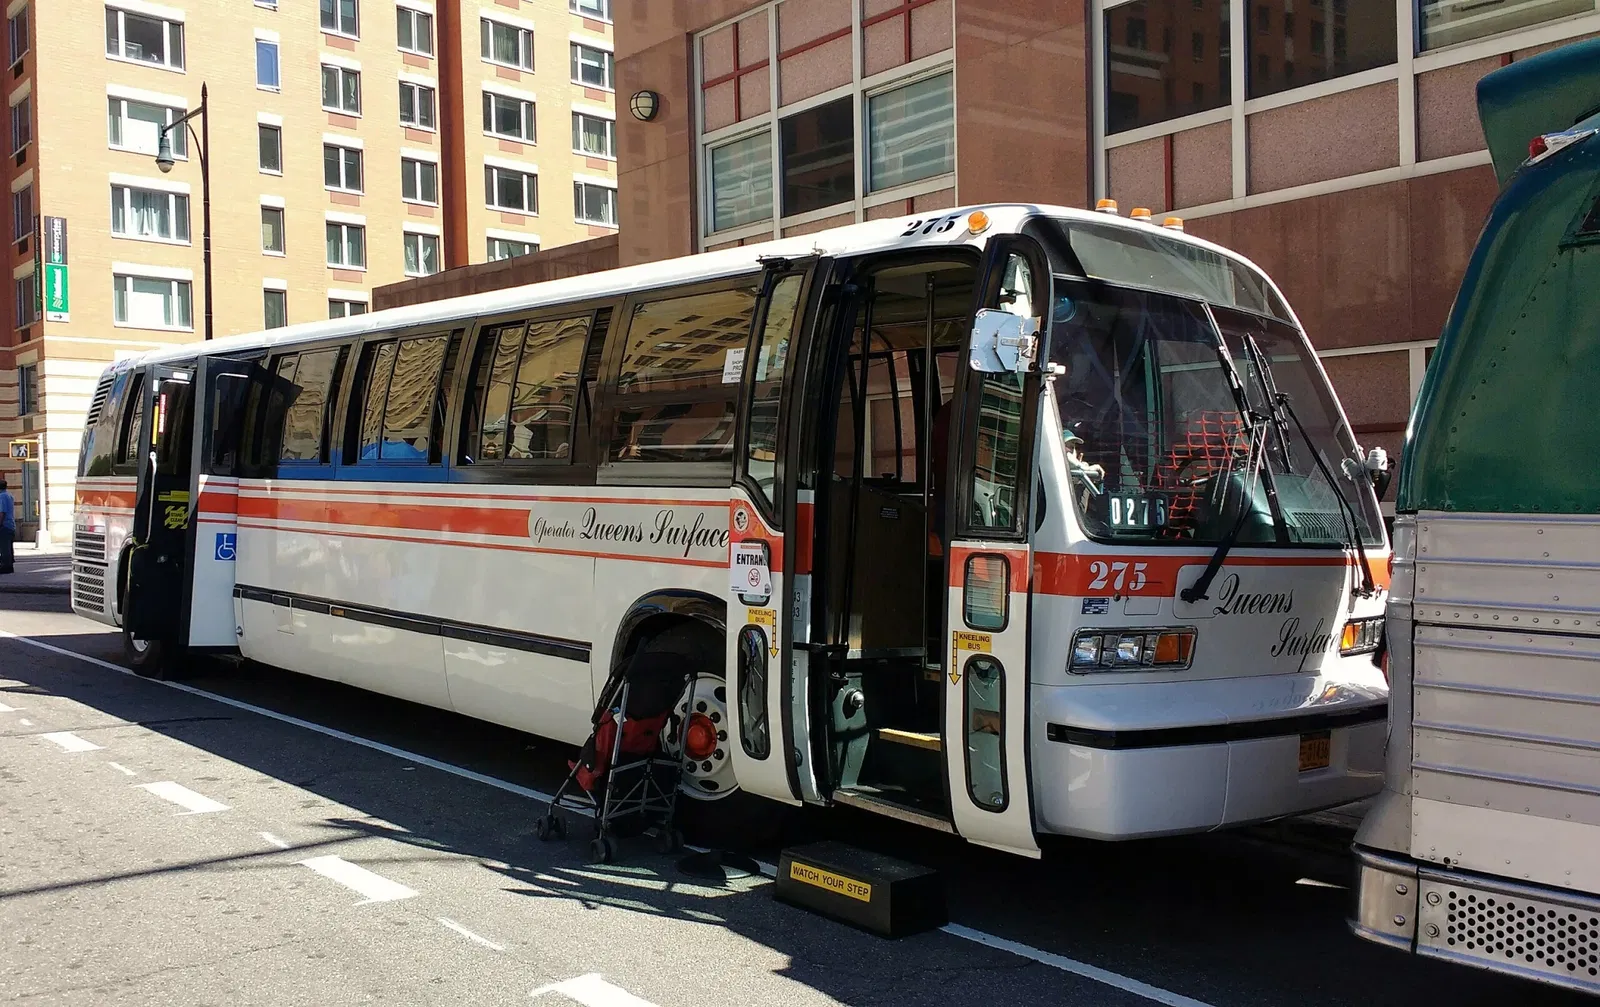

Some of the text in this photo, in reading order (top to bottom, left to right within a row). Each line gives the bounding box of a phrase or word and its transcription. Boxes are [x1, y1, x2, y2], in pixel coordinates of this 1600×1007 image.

[900, 215, 962, 237] 275
[1111, 498, 1165, 526] 0275
[534, 507, 730, 557] Operator Queens Surface
[736, 553, 766, 566] ENTRAN
[1088, 561, 1148, 591] 275
[1213, 573, 1294, 615] Queens
[748, 609, 771, 617] KNEELING
[959, 633, 990, 642] KNEELING
[793, 866, 869, 896] WATCH YOUR STEP
